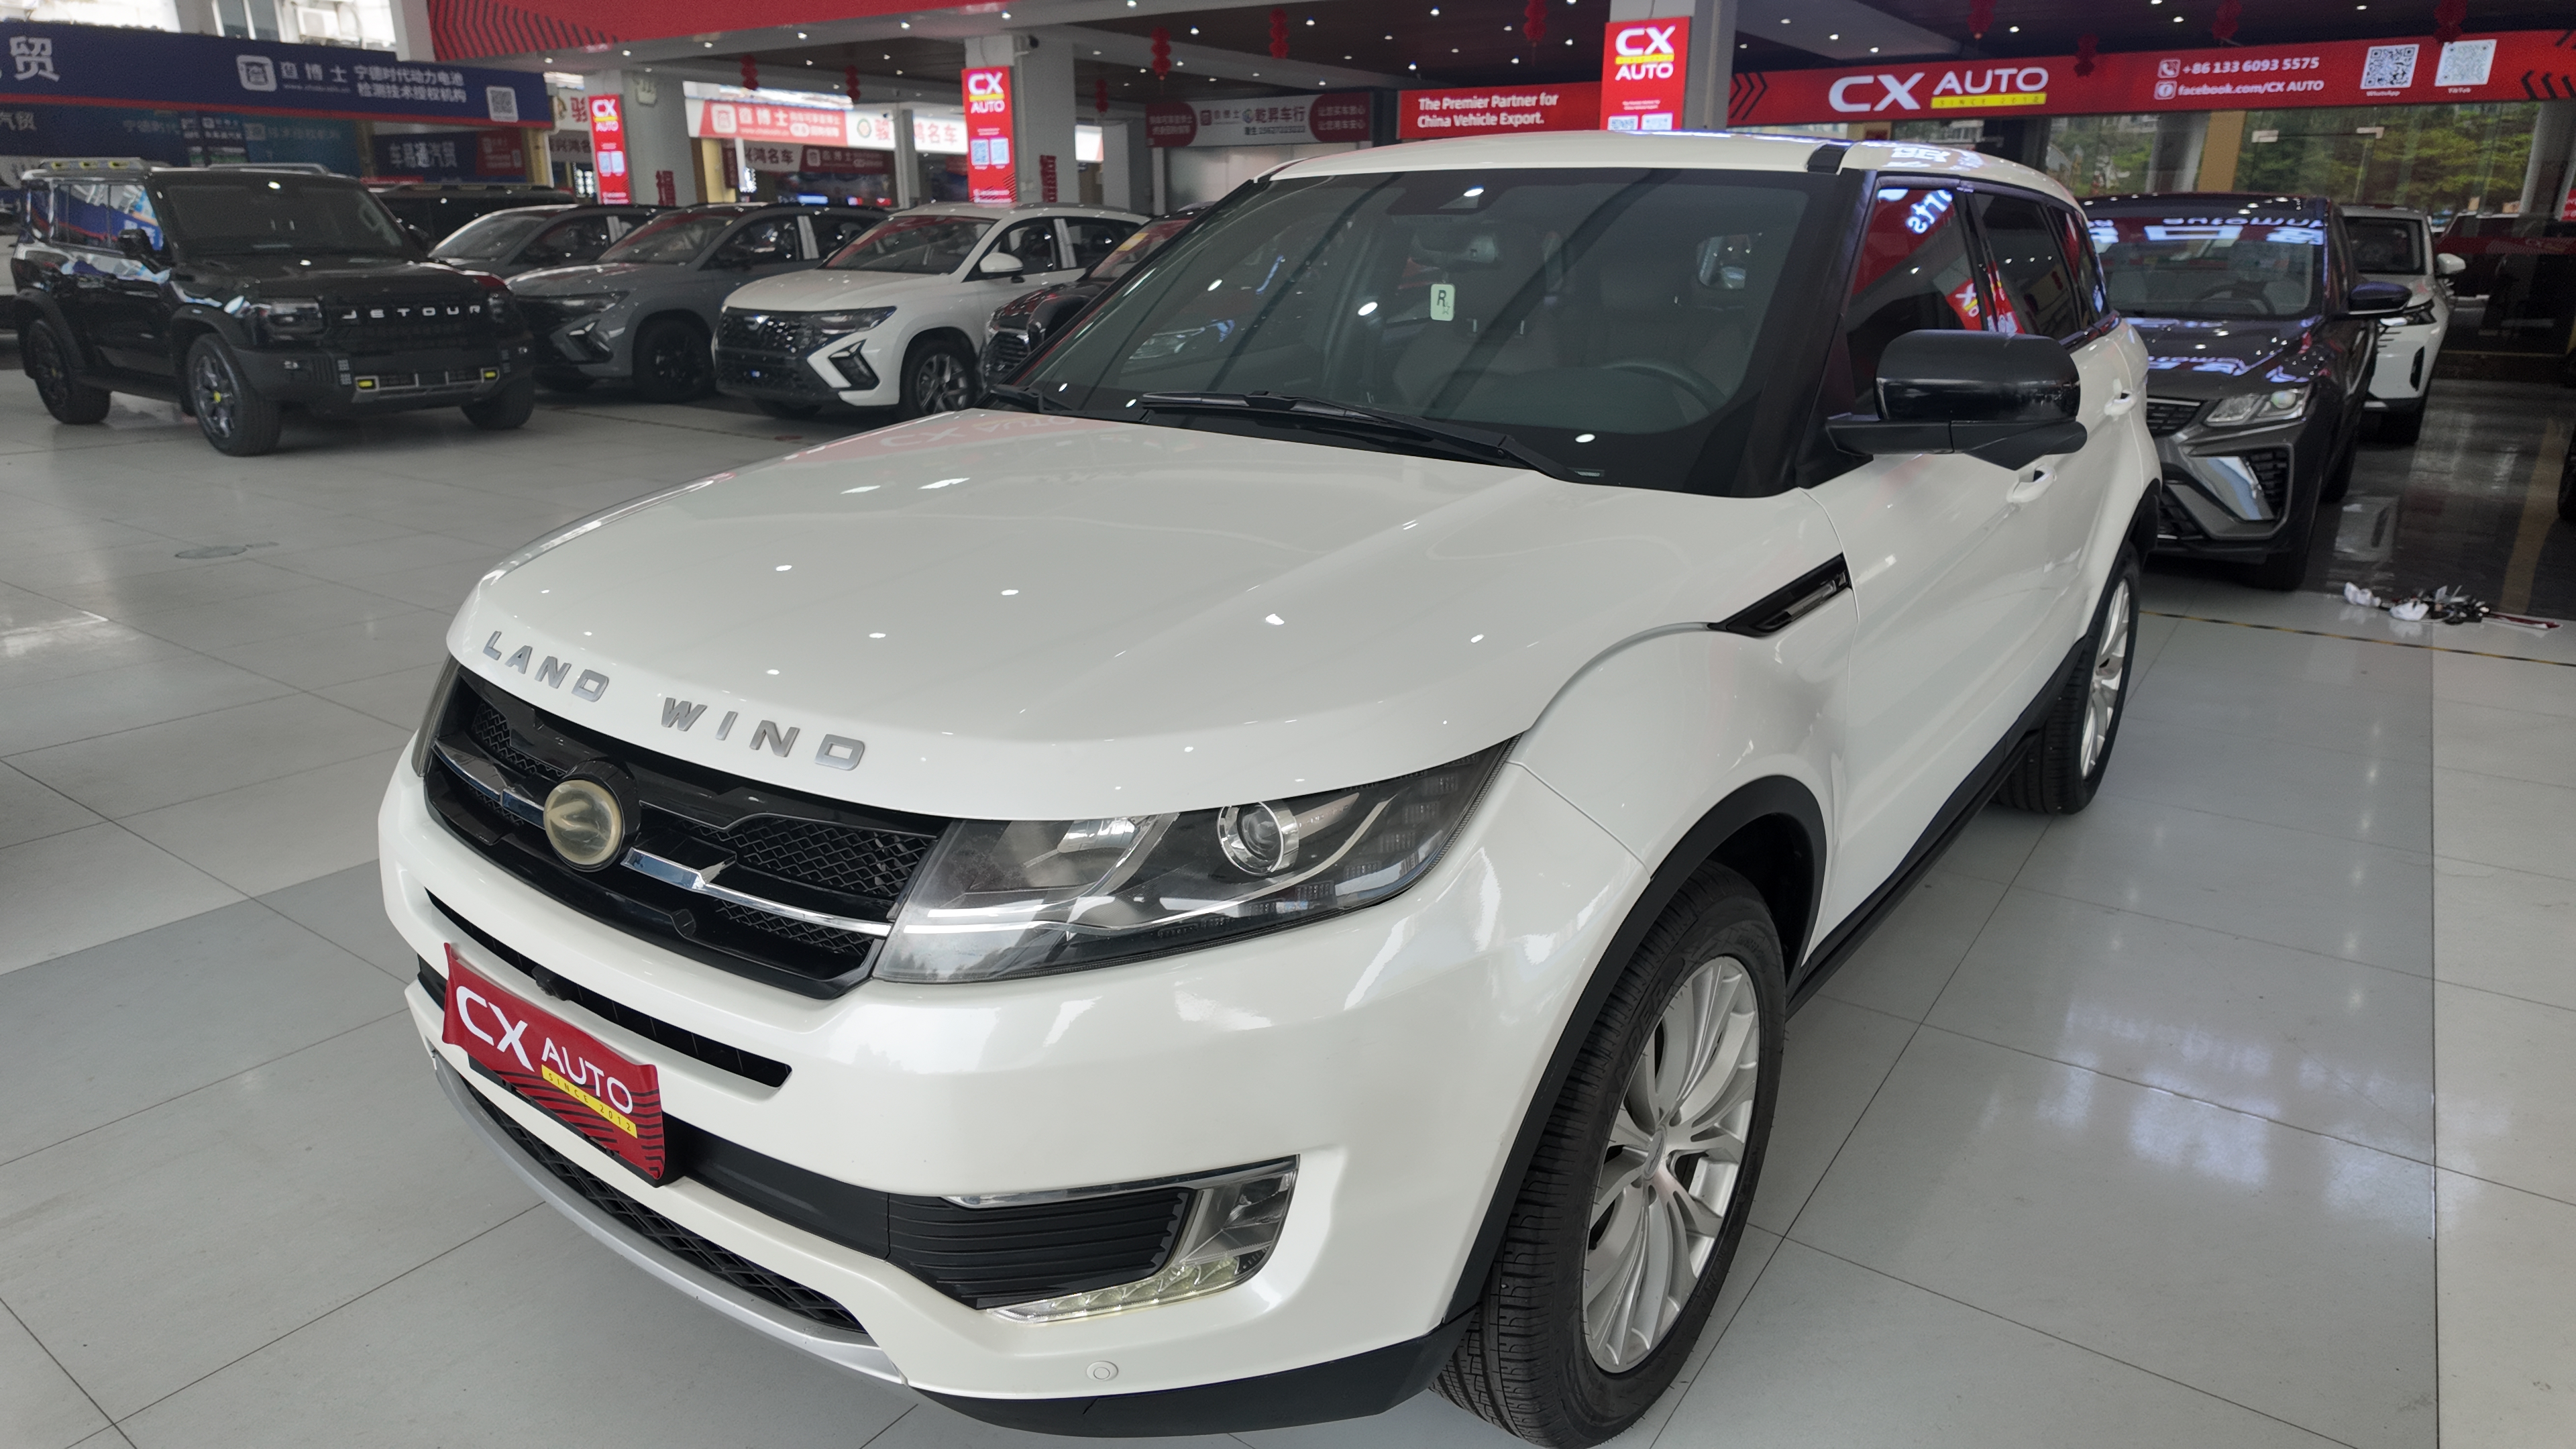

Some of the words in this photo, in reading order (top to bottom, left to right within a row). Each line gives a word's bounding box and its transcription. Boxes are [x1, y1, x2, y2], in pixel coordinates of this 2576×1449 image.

[1615, 25, 1676, 56] CX
[1615, 62, 1674, 80] AUTO
[2183, 62, 2210, 74] +86
[2213, 61, 2241, 74] 133
[2242, 58, 2279, 72] 6093
[2282, 56, 2320, 70] 5575
[968, 72, 1002, 94] CX
[1829, 72, 1925, 113] CX
[1933, 67, 2049, 95] AUTO
[2286, 80, 2324, 92] AUTO
[592, 99, 616, 116] CX
[971, 100, 1005, 113] AUTO
[1418, 98, 1440, 110] The
[1442, 96, 1489, 109] Premier
[1491, 94, 1538, 108] Partner
[1540, 92, 1558, 106] for
[596, 121, 619, 131] AUTO
[1417, 114, 1451, 127] China
[1453, 113, 1497, 126] Vehicle
[1499, 111, 1544, 127] Export.
[341, 304, 481, 319] JETOUR
[482, 630, 609, 702] LAND
[661, 696, 865, 771] WIND
[456, 985, 535, 1072] CX
[541, 1037, 633, 1114] AUTO
[548, 1073, 589, 1104] SINCE
[599, 1104, 631, 1131] 2012
